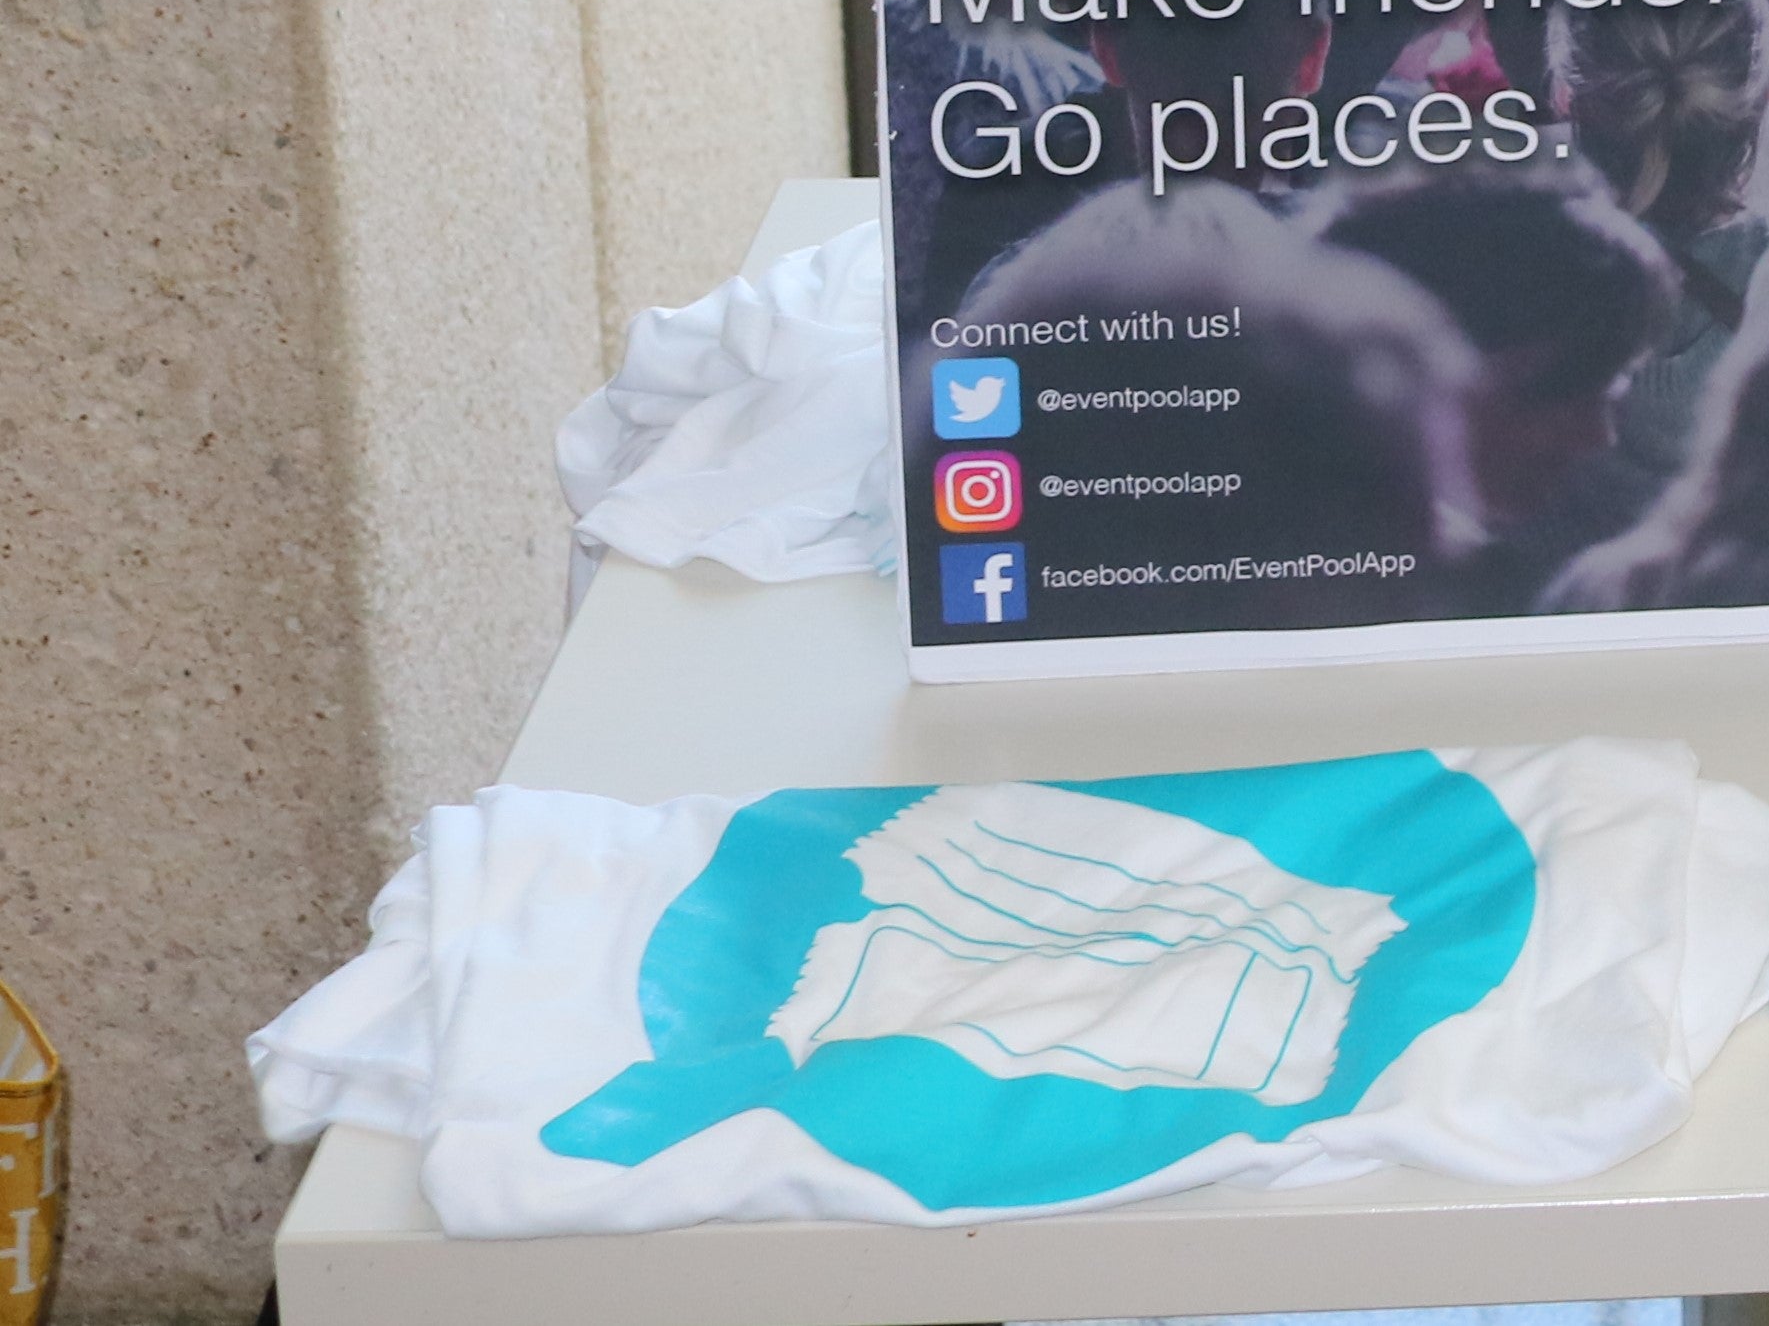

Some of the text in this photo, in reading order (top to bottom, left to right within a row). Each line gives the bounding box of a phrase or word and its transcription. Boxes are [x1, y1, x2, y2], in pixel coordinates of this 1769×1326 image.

[929, 74, 1571, 196] Go places.
[930, 306, 1242, 349] Connect with us!
[1037, 385, 1241, 414] @eventpoolapp
[1039, 472, 1242, 500] @eventpoolapp
[1041, 550, 1417, 589] facebook.com/EventPoolApp
